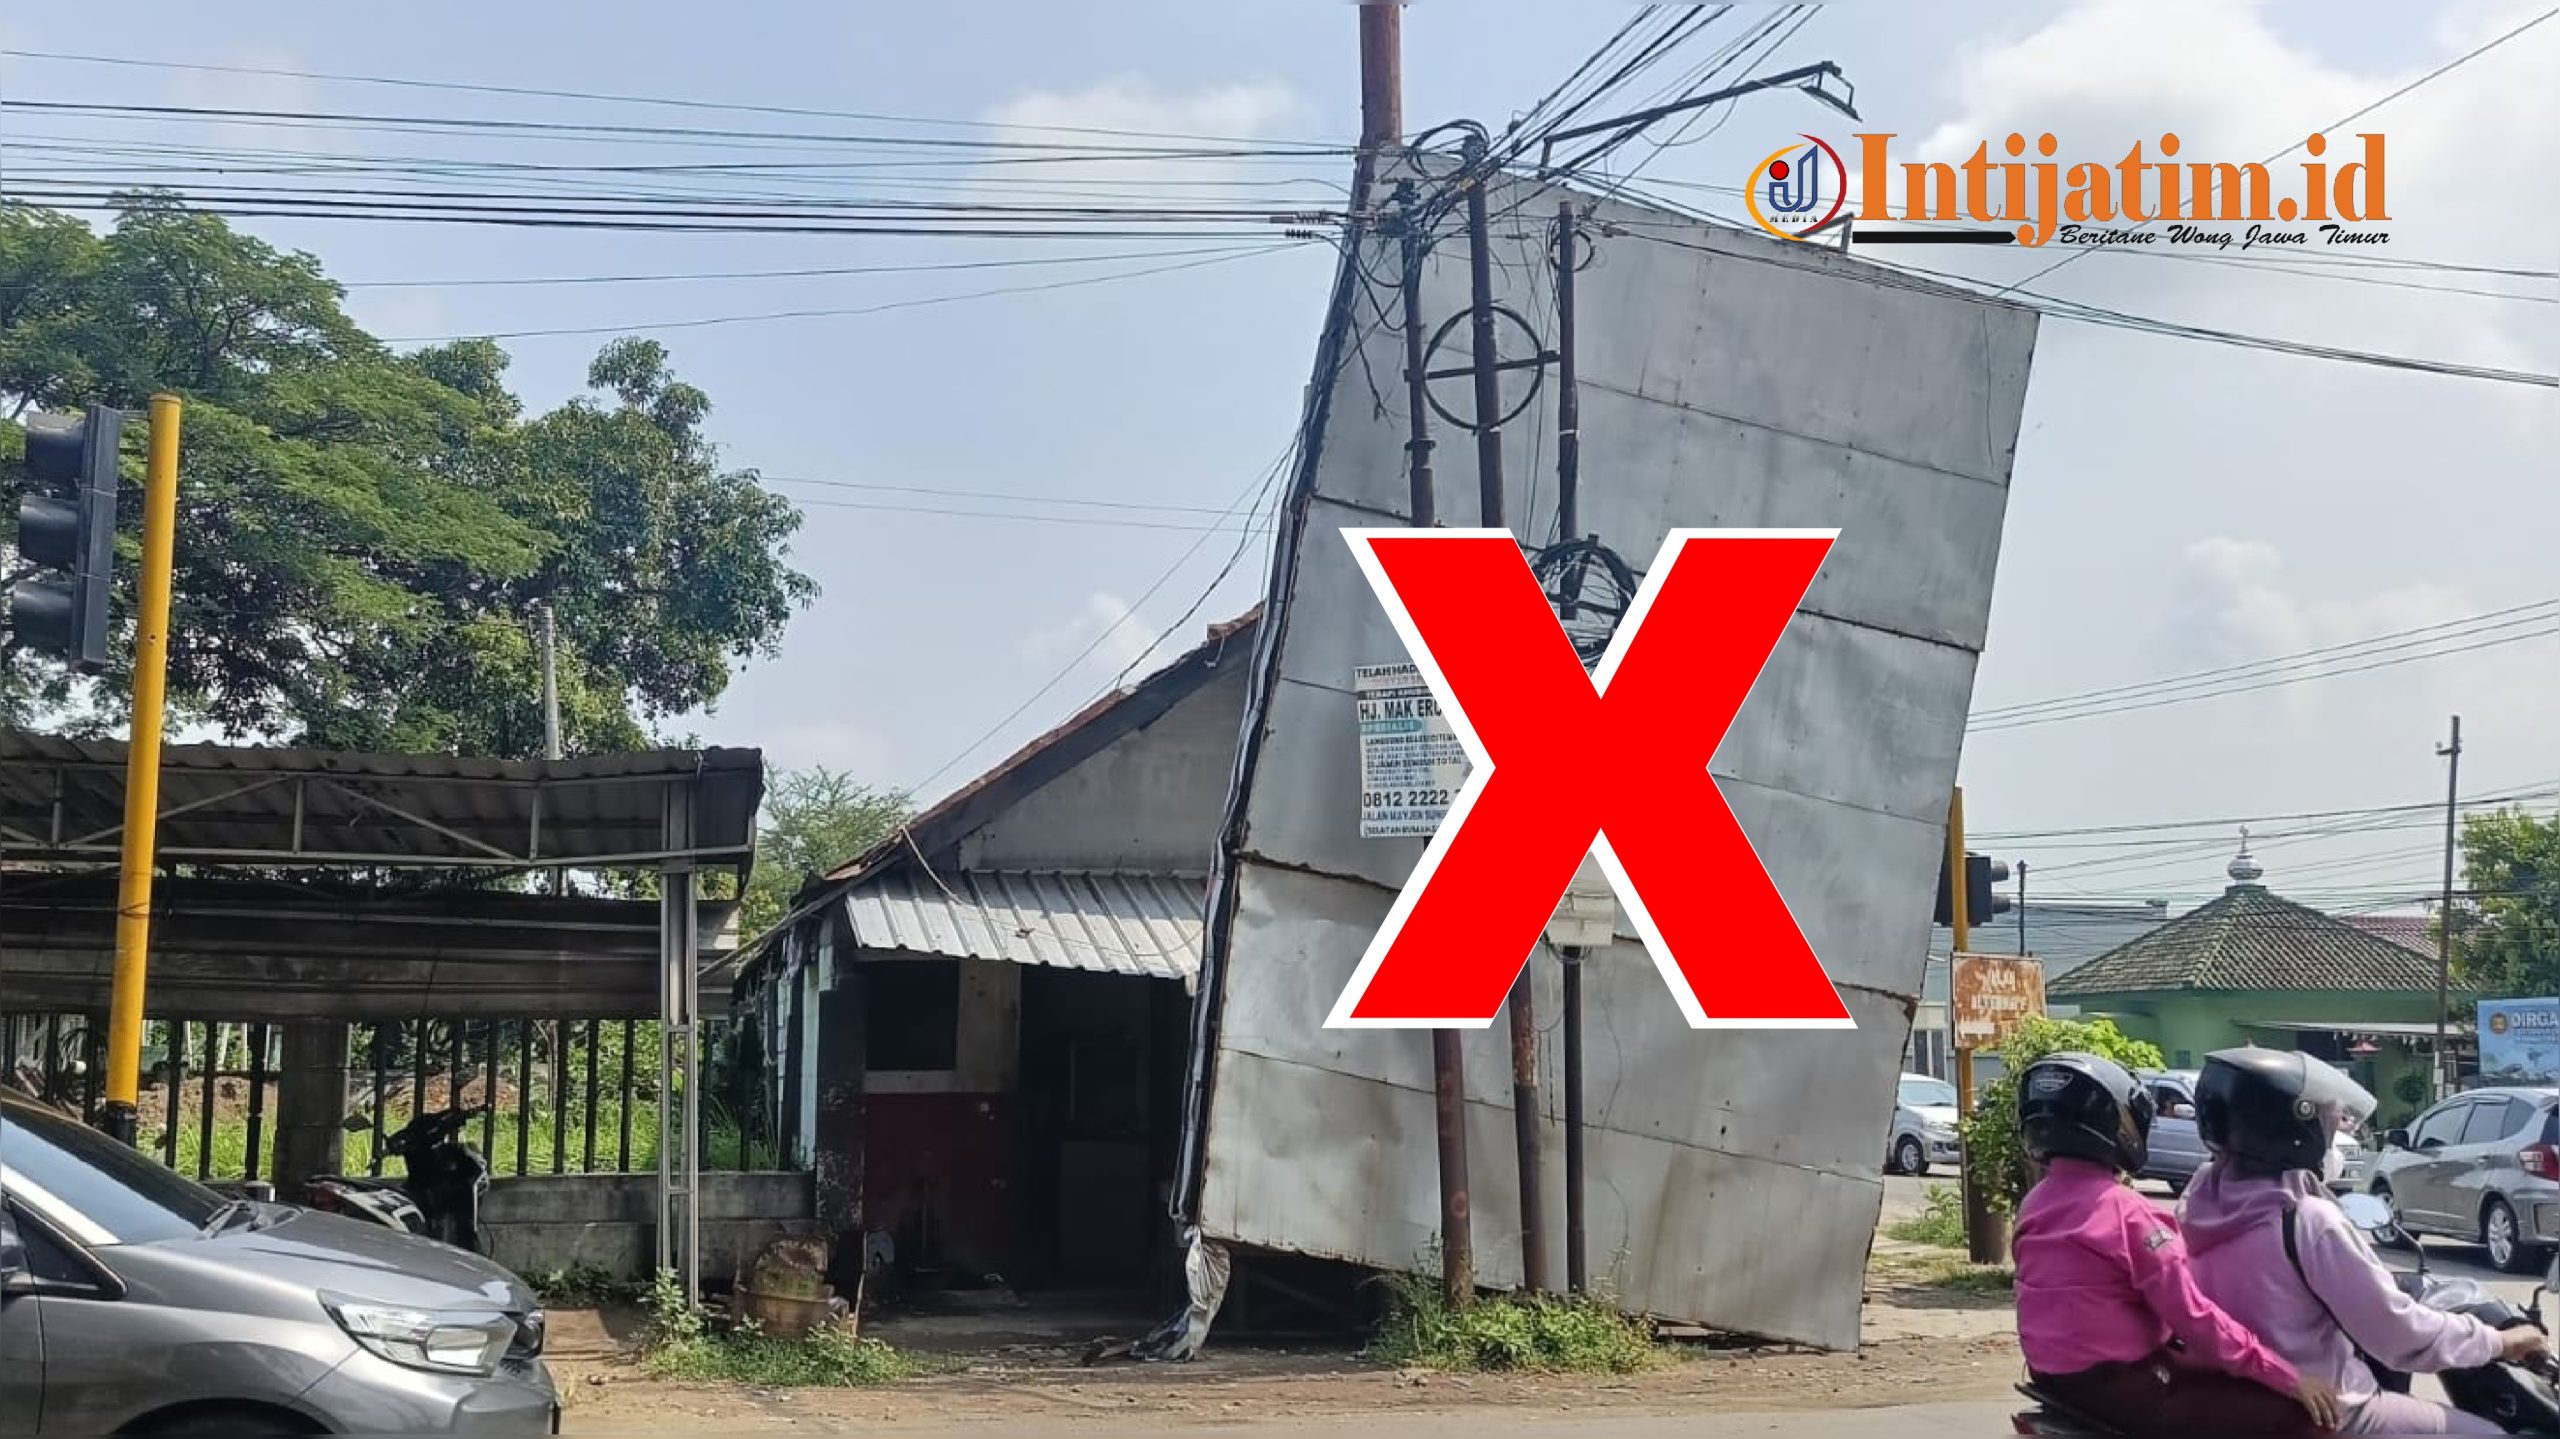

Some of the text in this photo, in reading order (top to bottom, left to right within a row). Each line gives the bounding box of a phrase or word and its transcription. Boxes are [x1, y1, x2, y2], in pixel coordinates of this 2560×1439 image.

[1360, 702, 1381, 720] HJ.
[1385, 699, 1413, 719] MAK
[1363, 789, 1450, 808] 0812 2222
